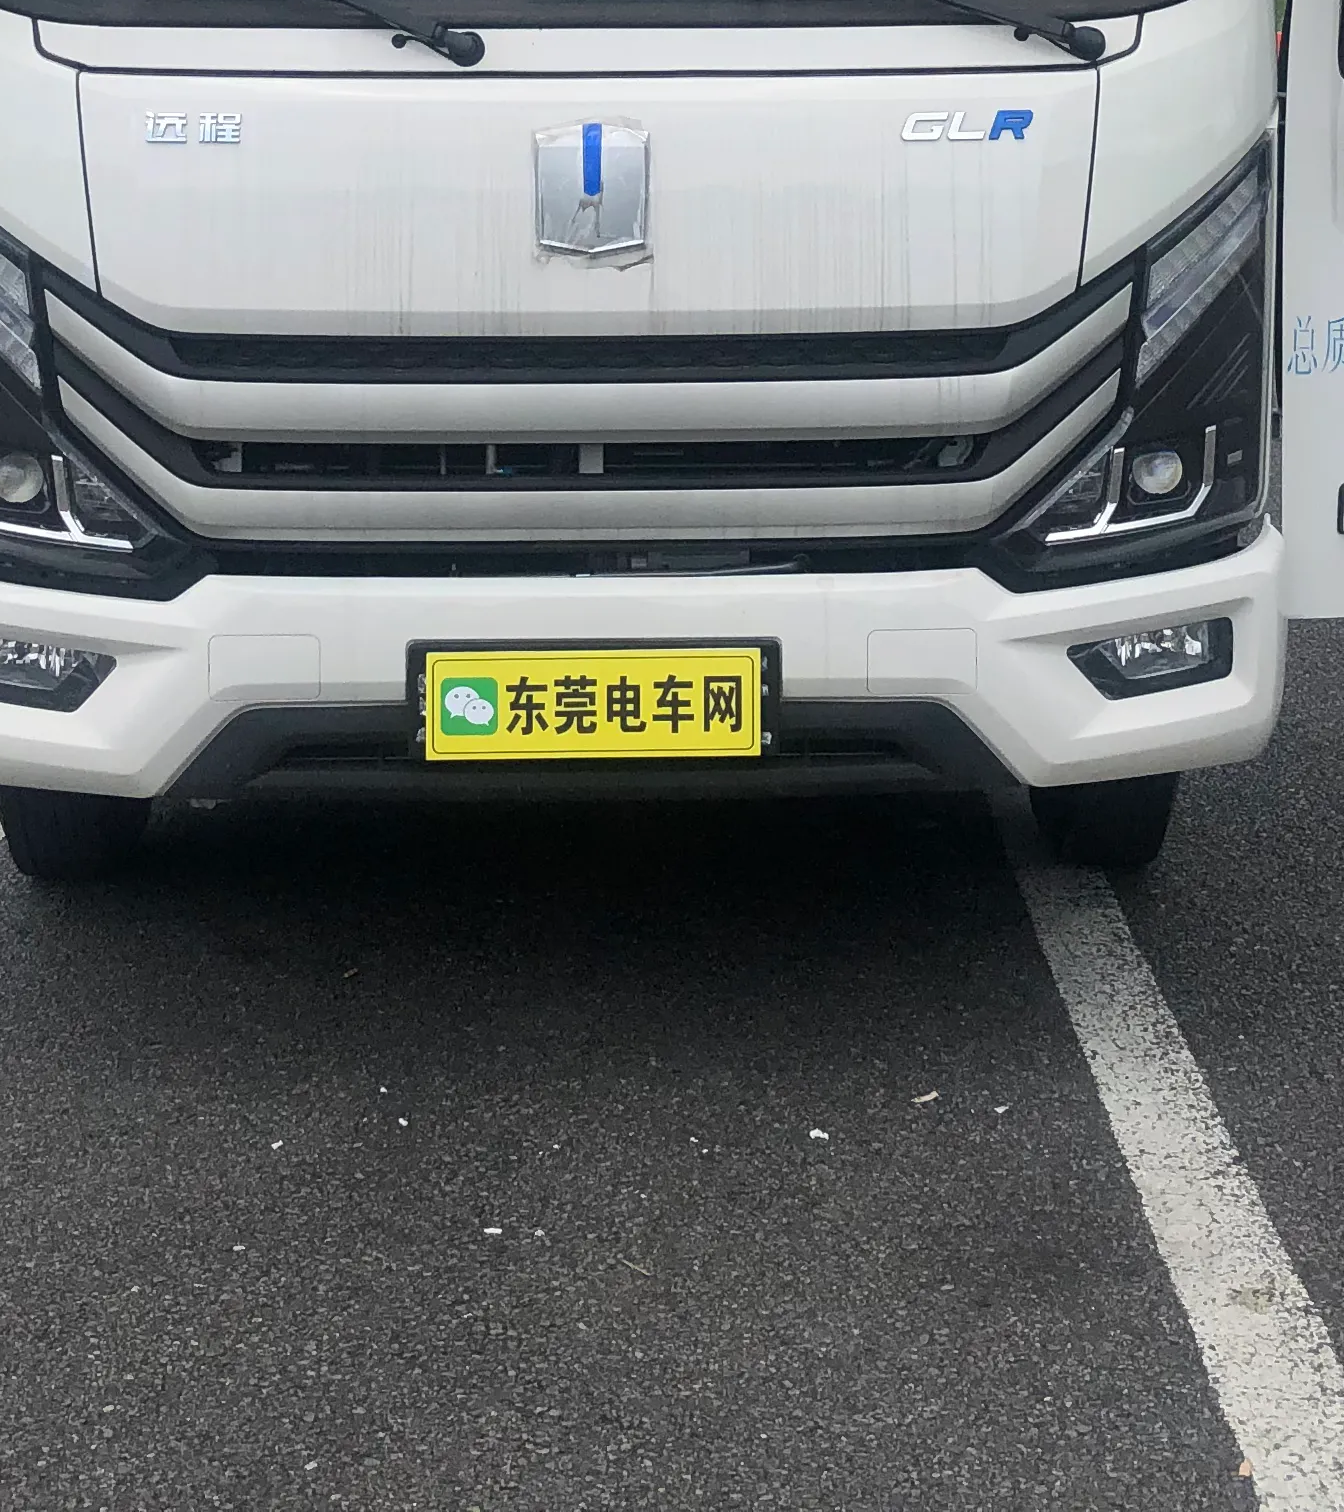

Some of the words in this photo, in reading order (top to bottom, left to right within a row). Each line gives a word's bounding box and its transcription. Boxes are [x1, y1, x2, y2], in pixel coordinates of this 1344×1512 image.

[145, 107, 243, 144] 远程
[901, 108, 1034, 141] GLR
[504, 673, 743, 736] 东莞电车网
